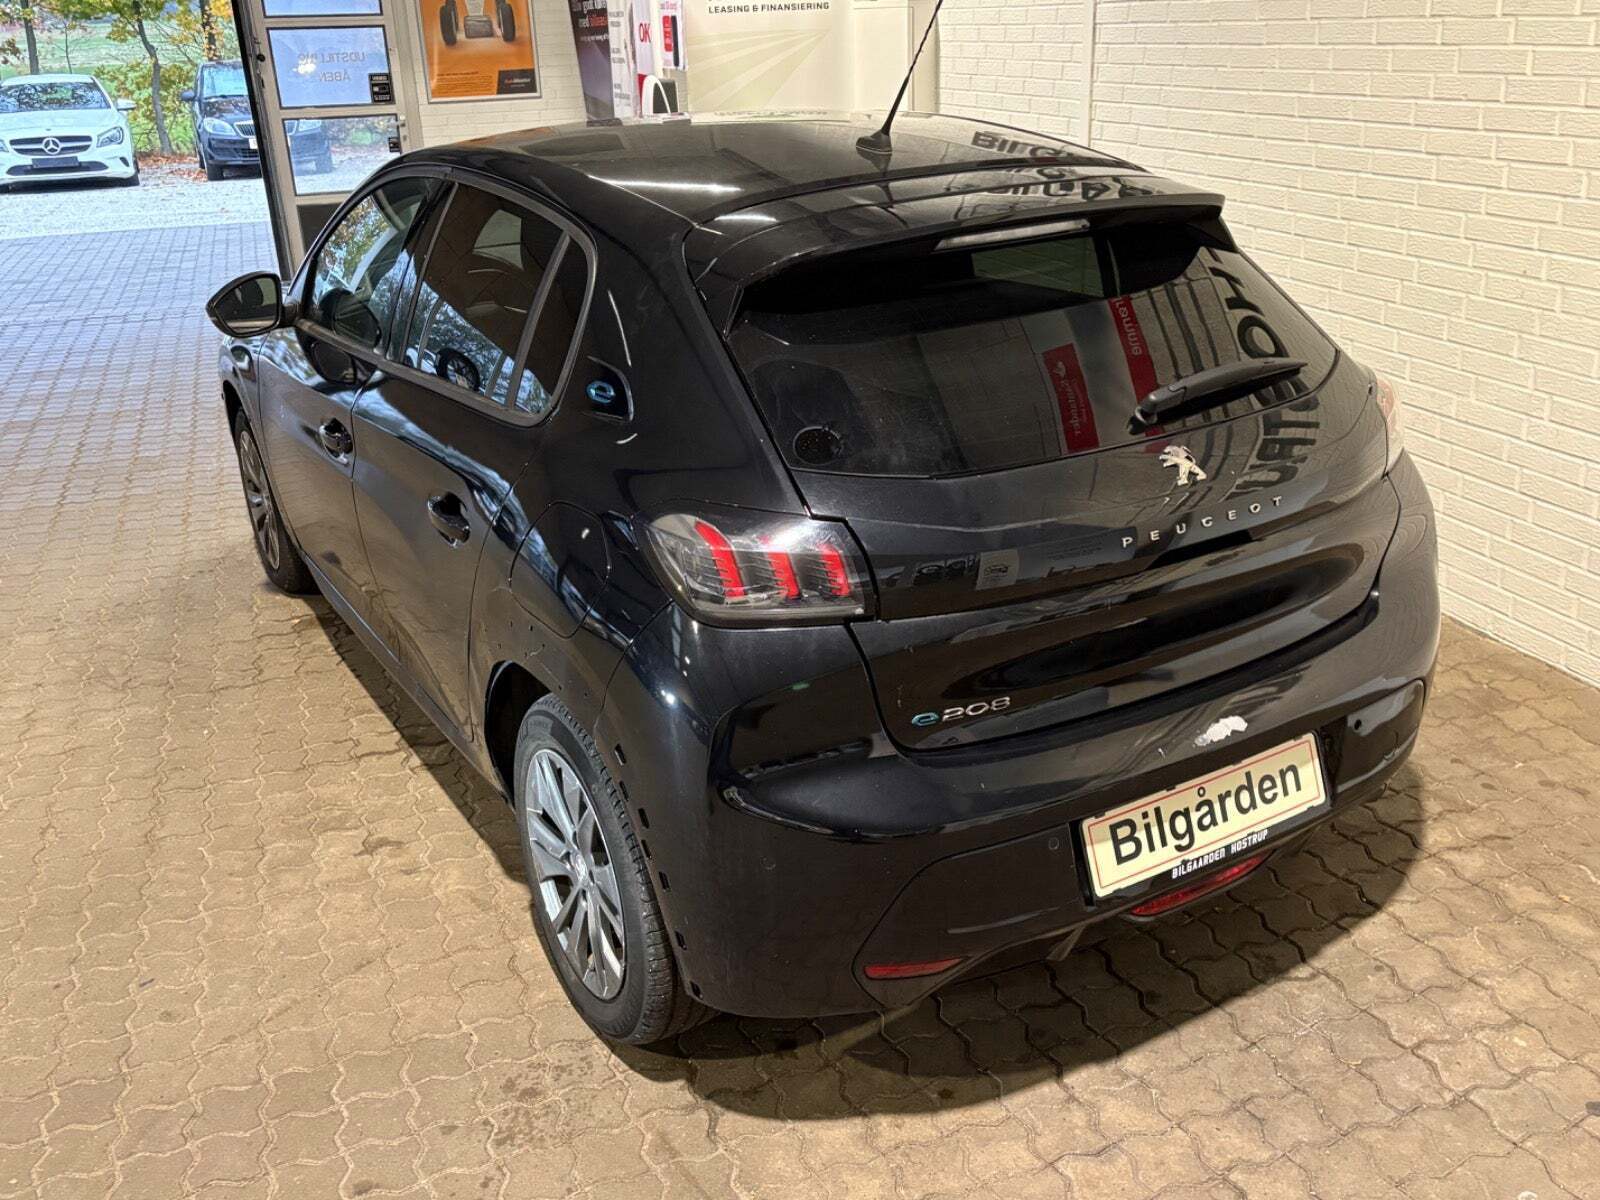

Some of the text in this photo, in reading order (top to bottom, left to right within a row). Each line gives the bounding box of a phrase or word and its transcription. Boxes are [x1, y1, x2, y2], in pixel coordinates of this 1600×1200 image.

[639, 23, 651, 43] OK
[708, 1, 830, 14] LEASING & FINANSIERING
[1121, 495, 1283, 549] PEUGEOT
[1109, 763, 1302, 866] Bilgården
[1171, 829, 1269, 880] BILGAARDEN HOSTRUP
